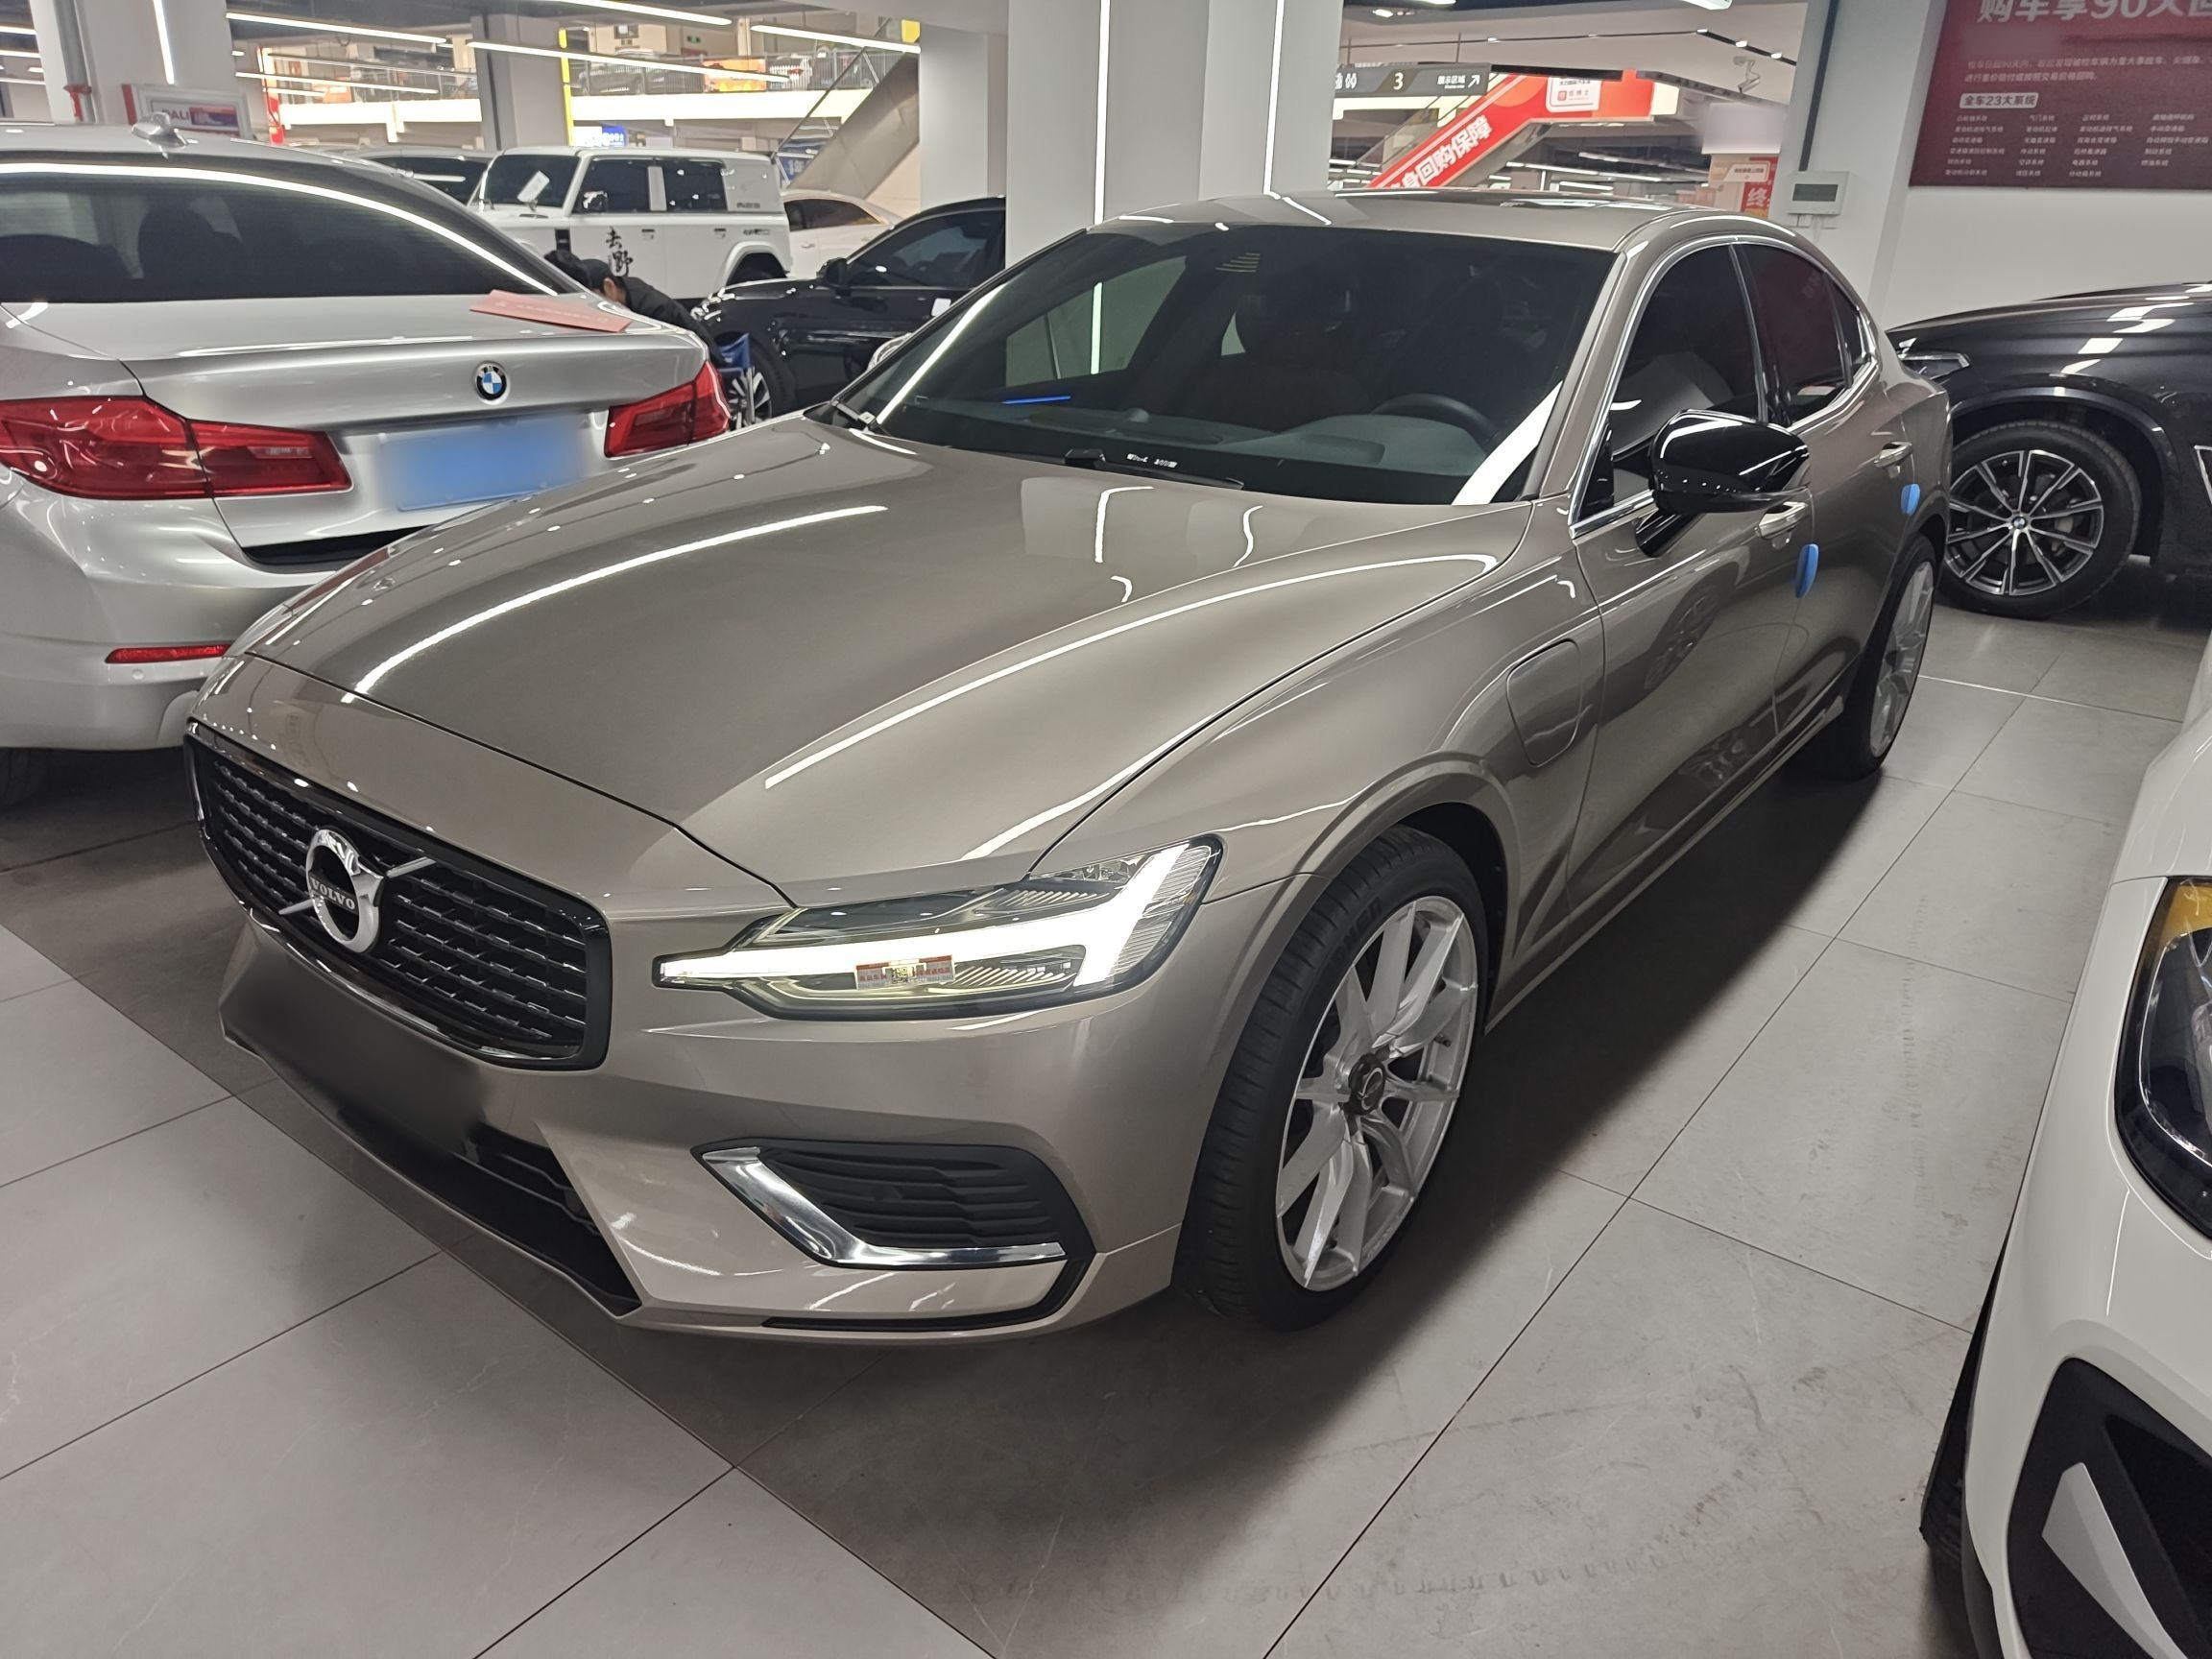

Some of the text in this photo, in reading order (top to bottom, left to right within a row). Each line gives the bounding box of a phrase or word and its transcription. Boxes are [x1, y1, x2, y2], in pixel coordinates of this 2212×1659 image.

[1392, 72, 1404, 90] 3
[1964, 95, 2035, 106] 全车23大系统
[1391, 114, 1492, 187] 身回购保障
[310, 877, 355, 910] VOLVO
